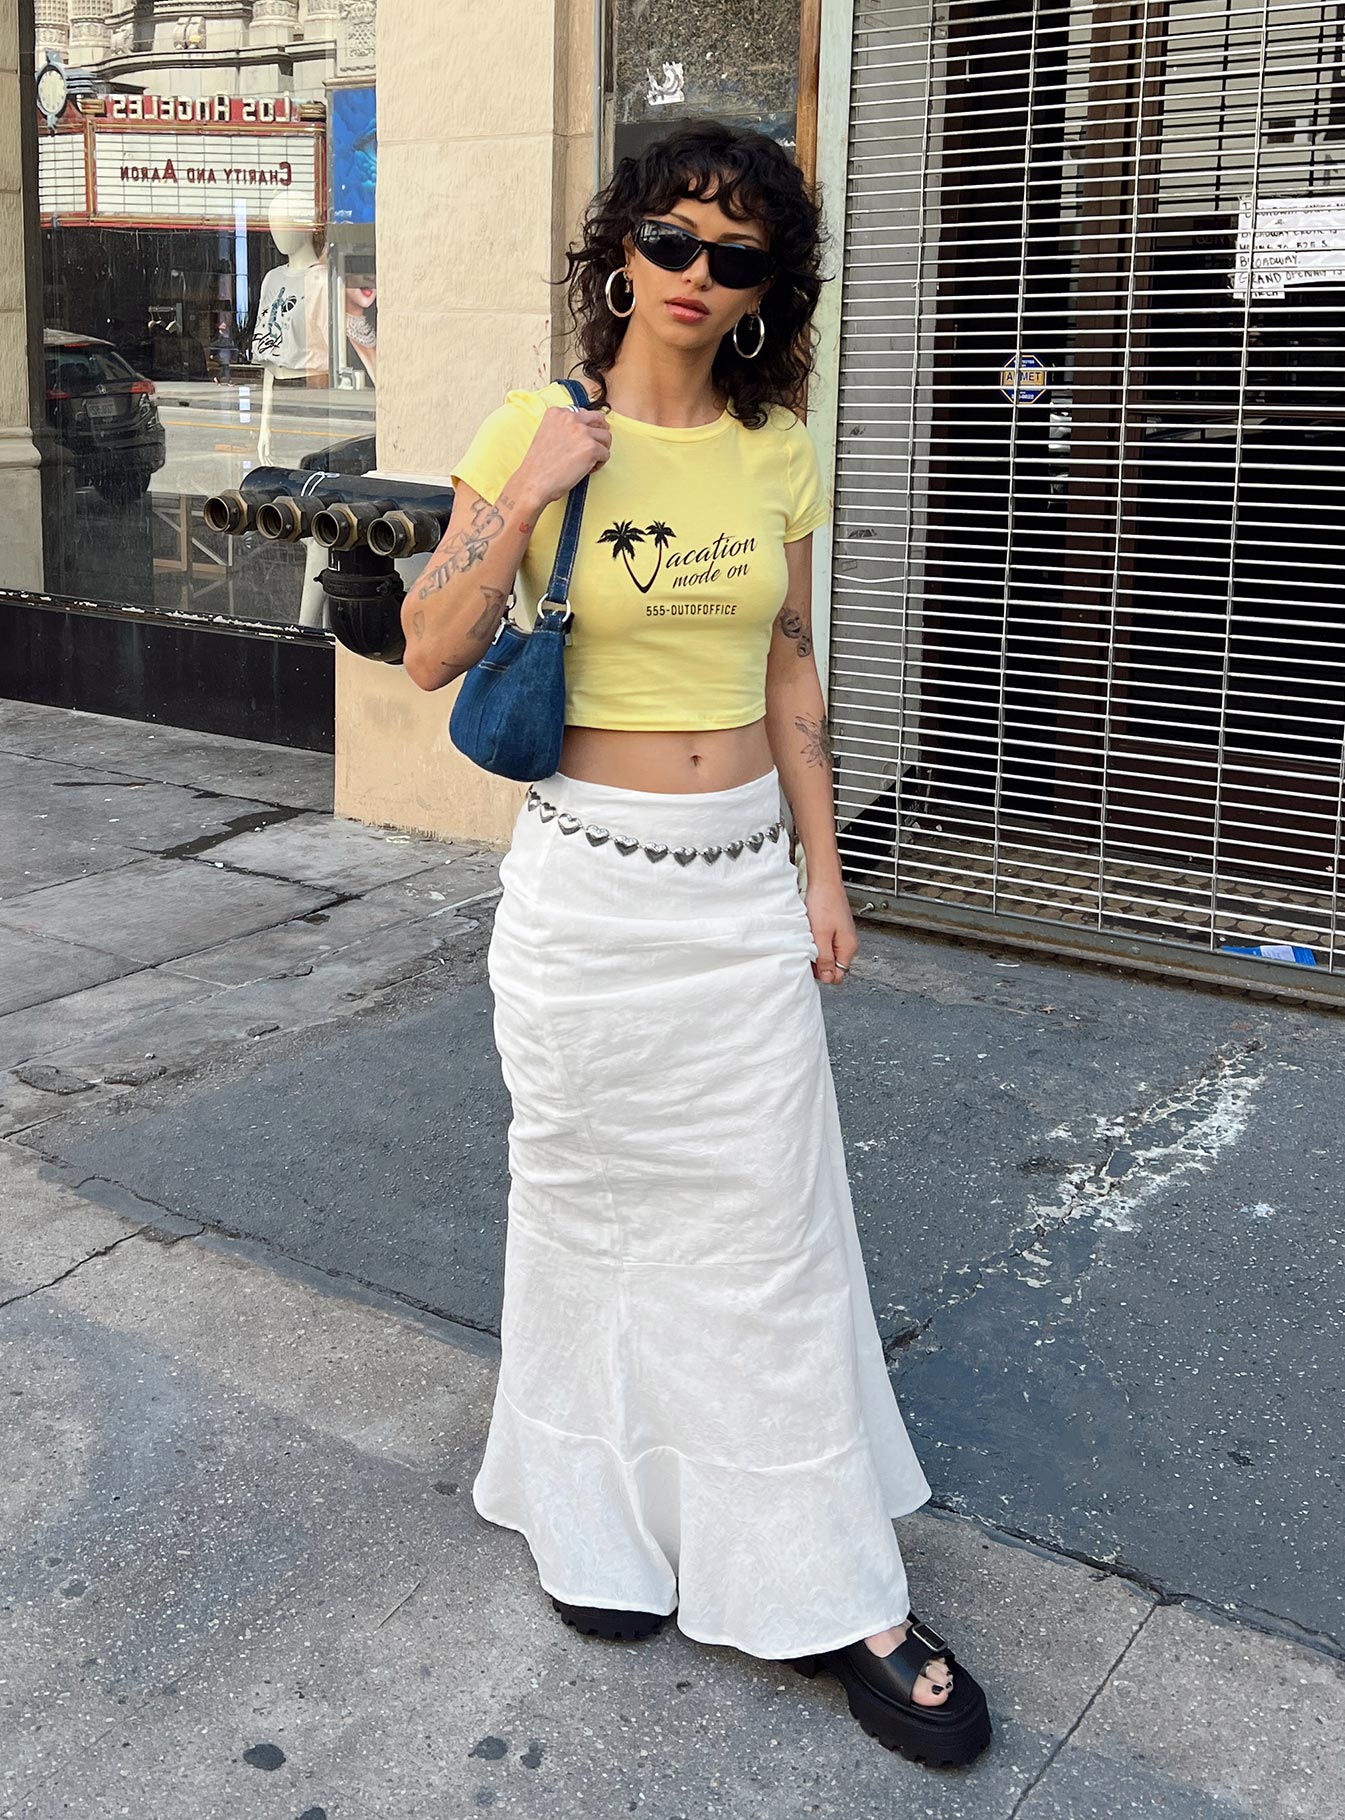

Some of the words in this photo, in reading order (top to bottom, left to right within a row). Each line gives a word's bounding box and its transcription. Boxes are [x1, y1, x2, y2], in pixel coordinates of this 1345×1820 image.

[672, 560, 721, 589] mode
[727, 563, 751, 579] on
[646, 604, 738, 617] 555-OUTOFOFFICE
